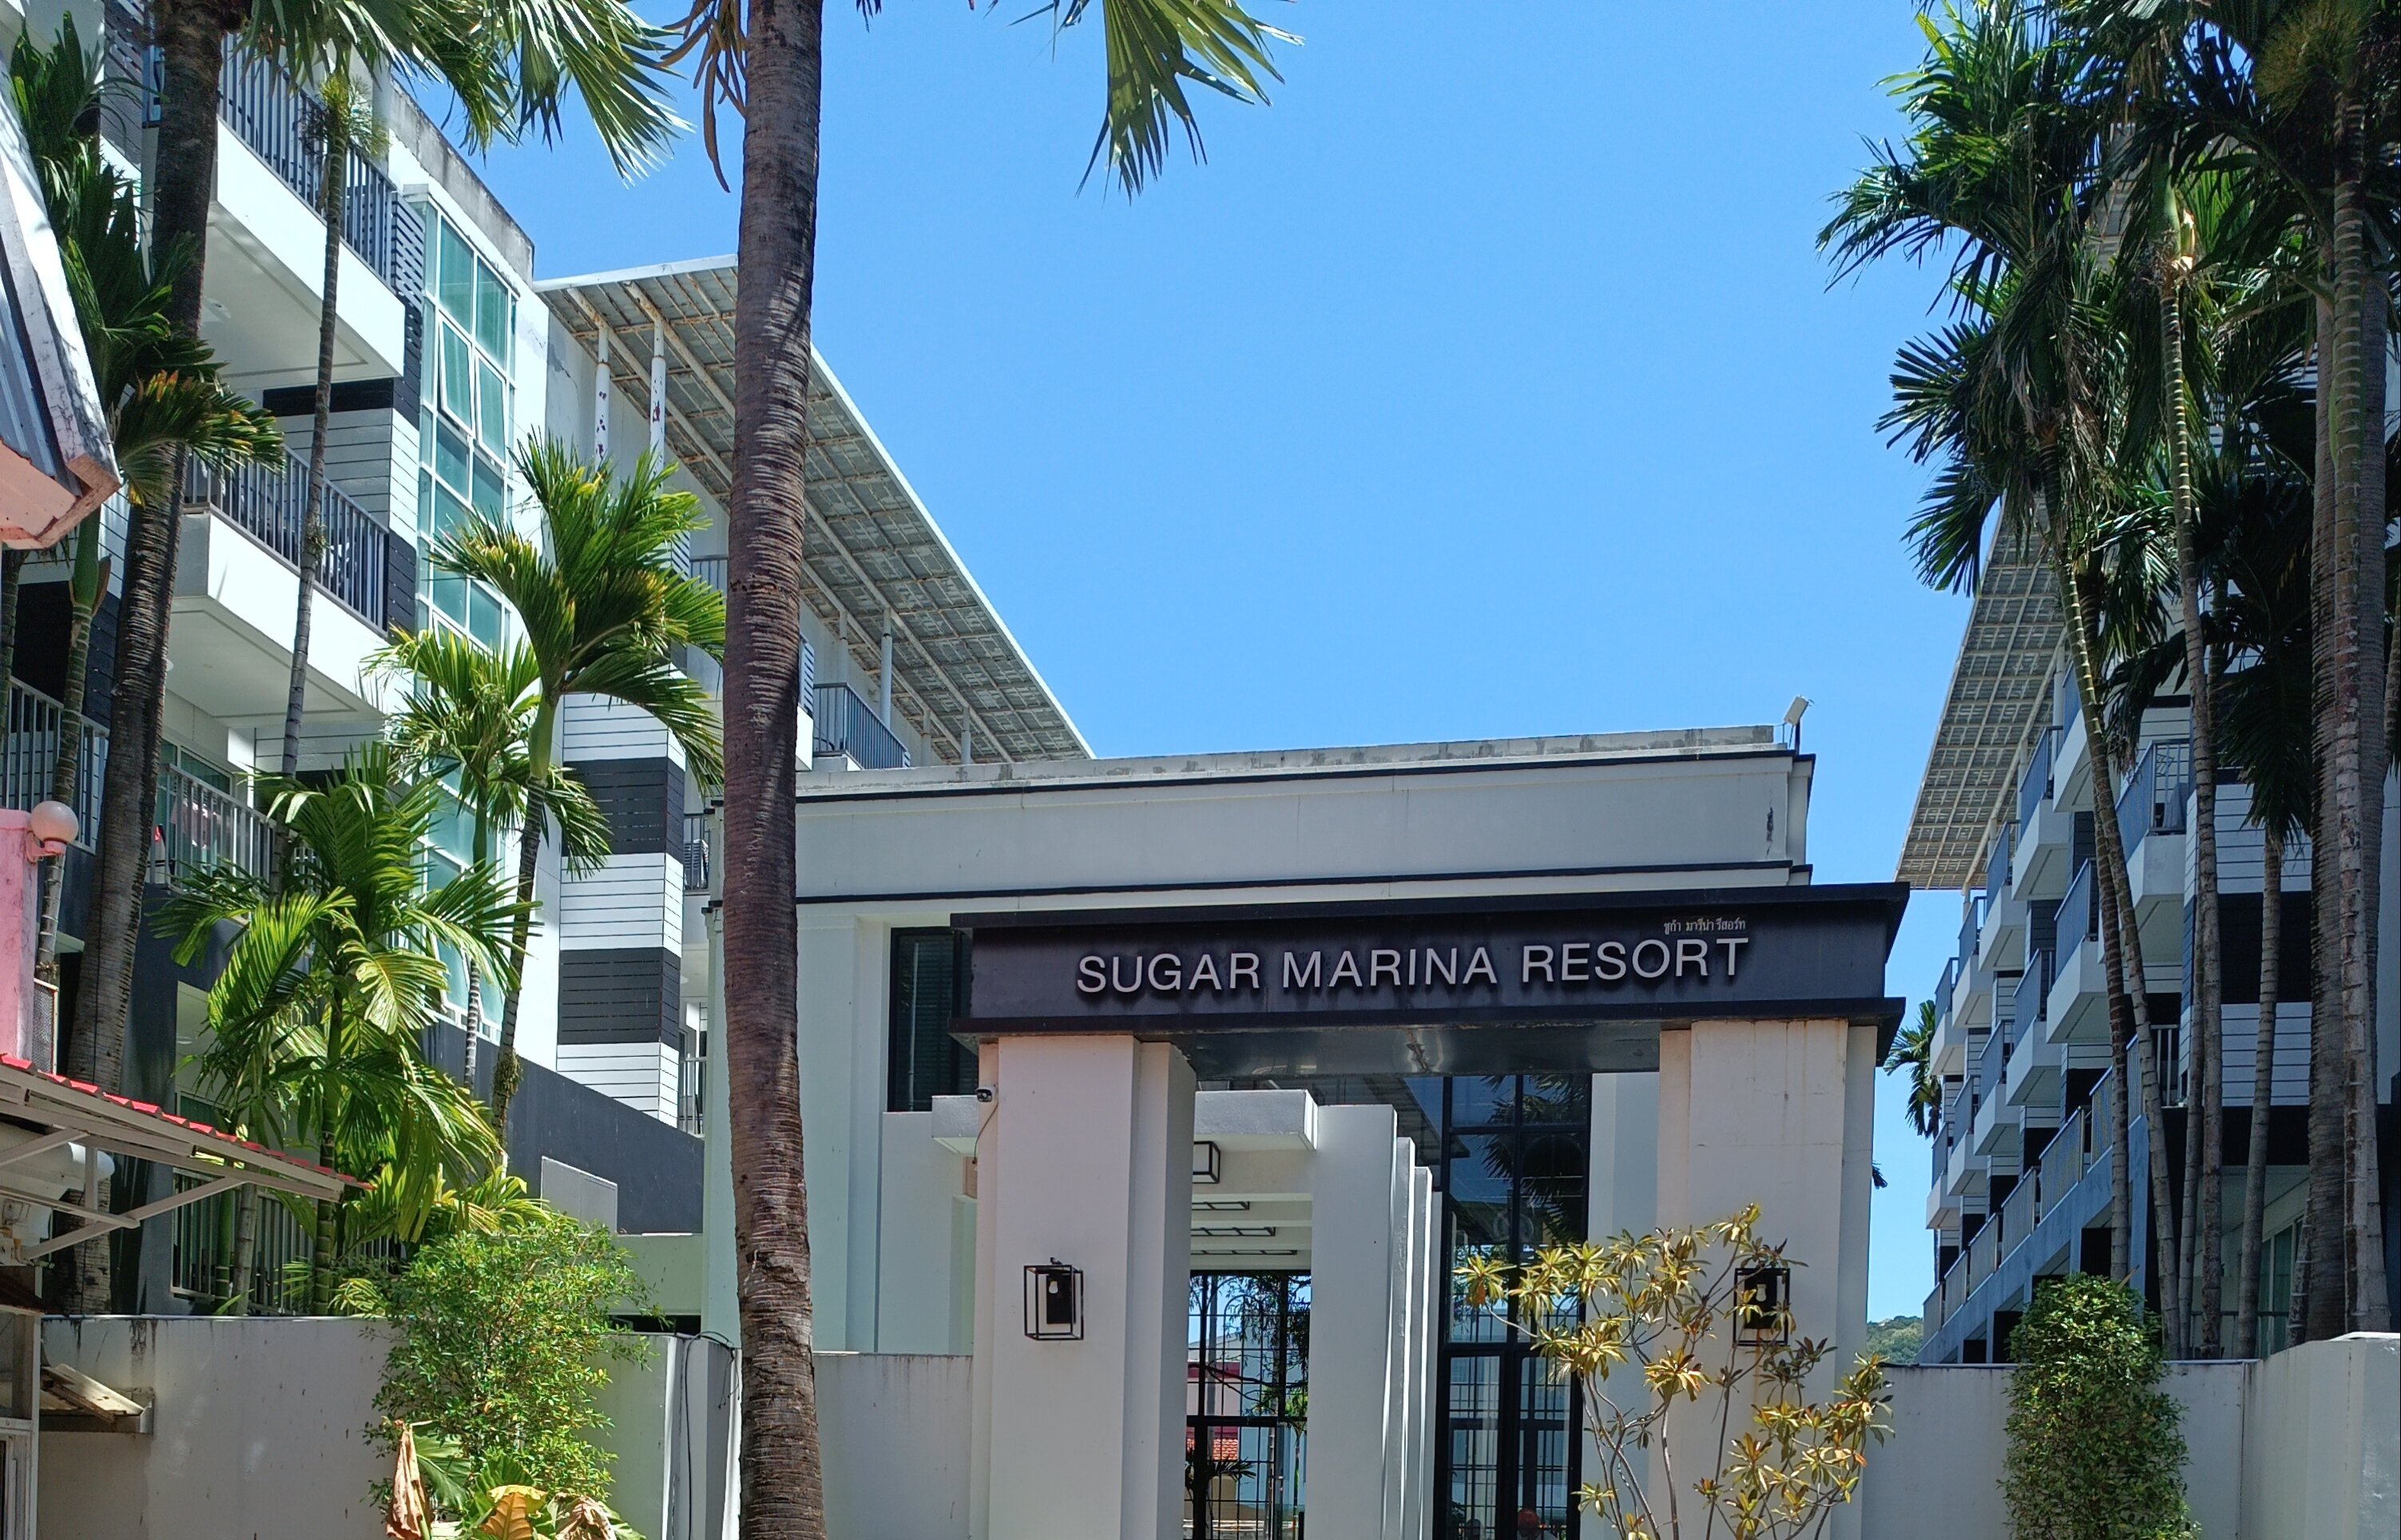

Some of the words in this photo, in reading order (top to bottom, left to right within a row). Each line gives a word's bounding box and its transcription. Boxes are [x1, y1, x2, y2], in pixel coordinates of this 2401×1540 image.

[1077, 952, 1260, 994] SUGAR
[1283, 947, 1497, 989] MARINA
[1522, 937, 1749, 983] RESORT
